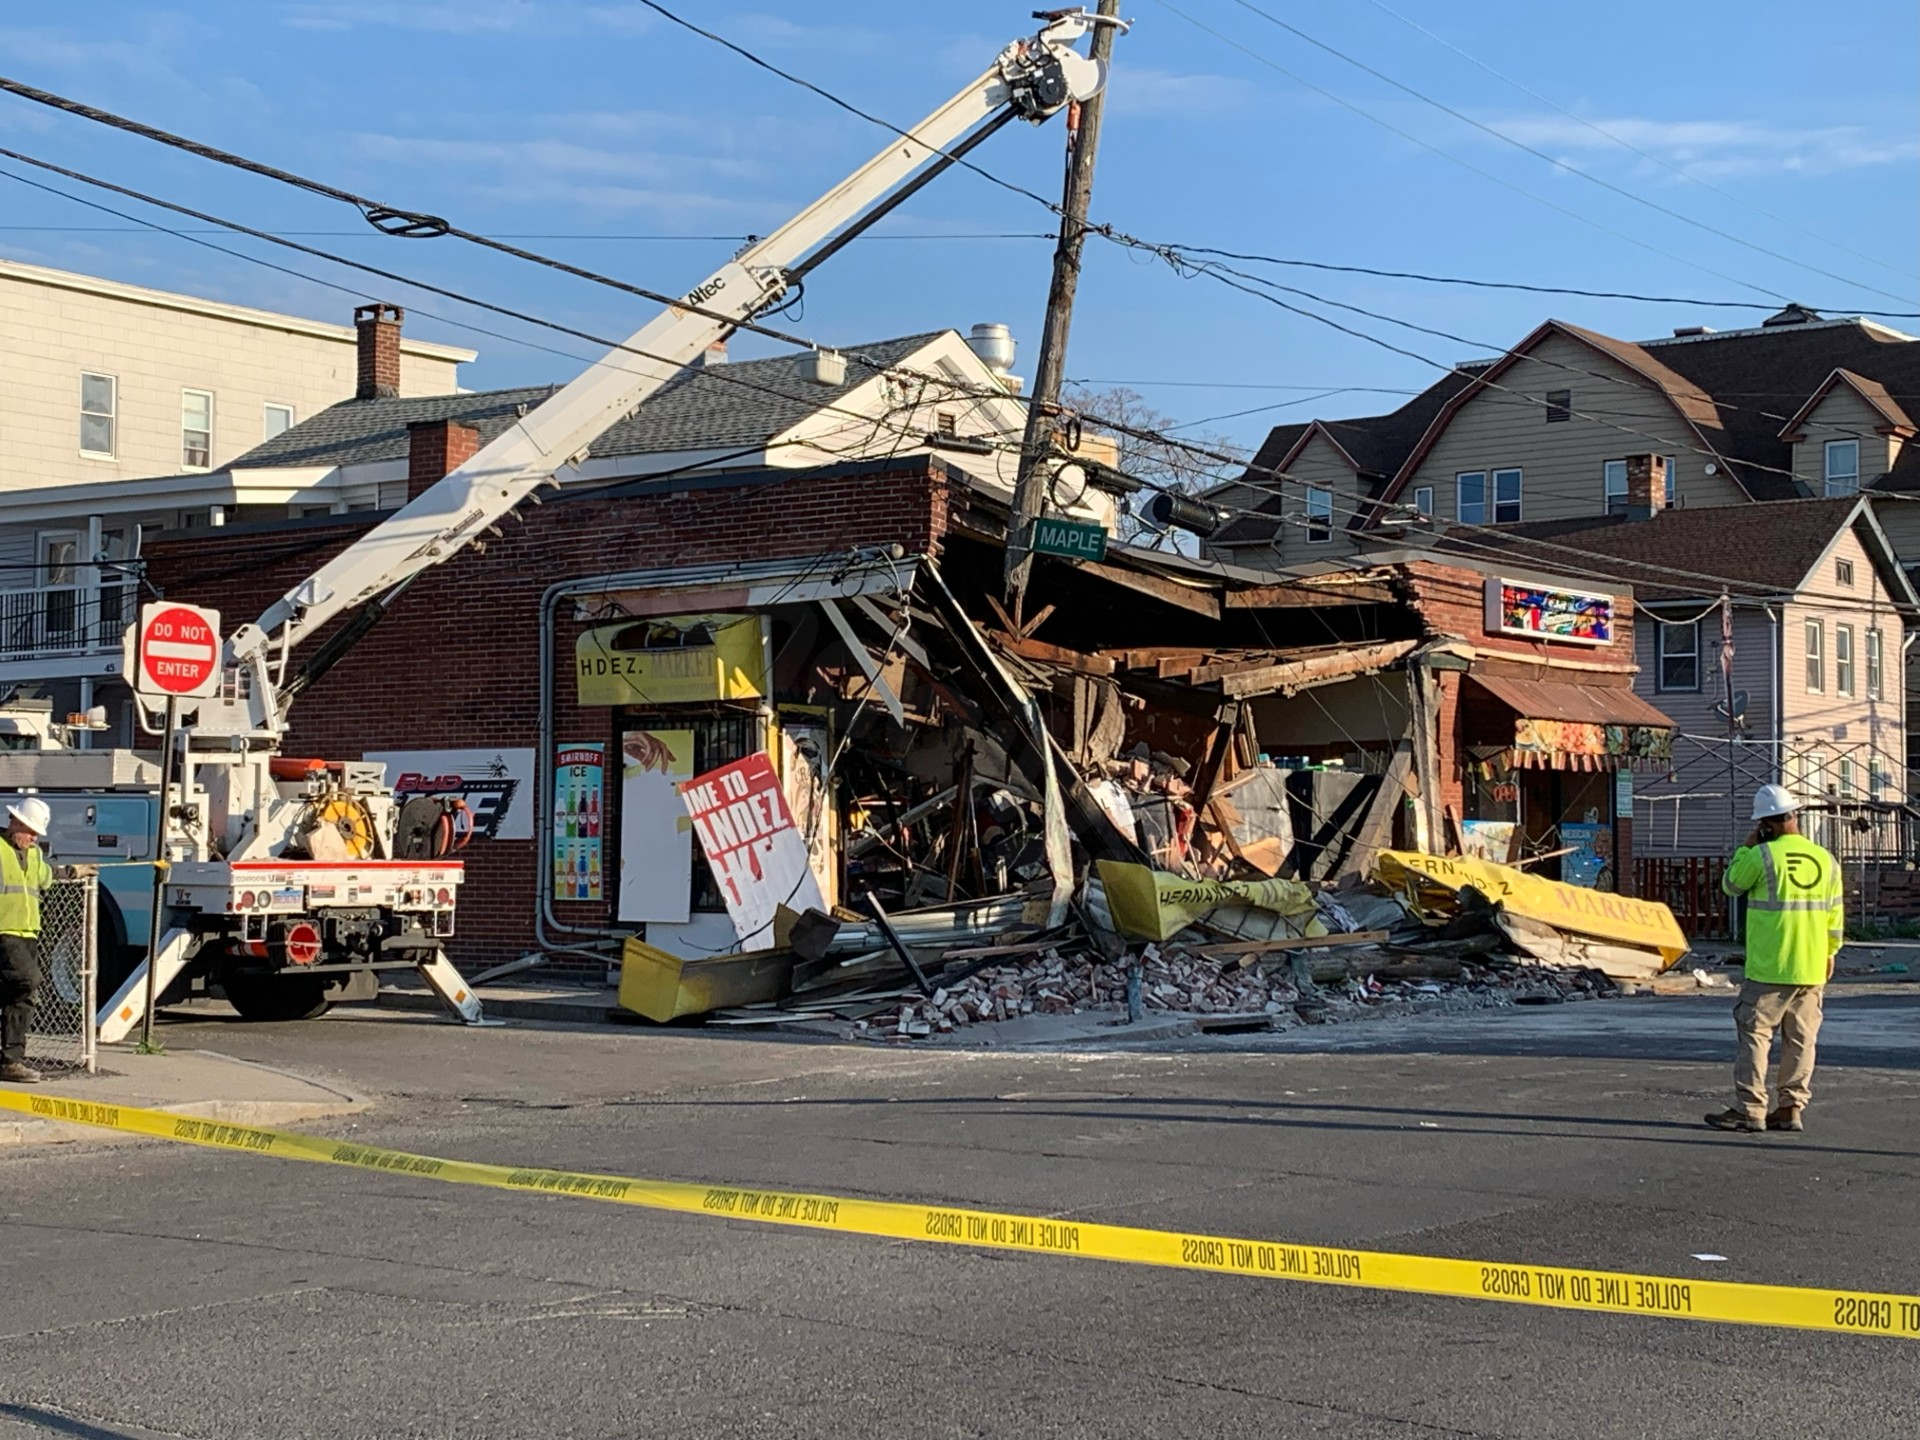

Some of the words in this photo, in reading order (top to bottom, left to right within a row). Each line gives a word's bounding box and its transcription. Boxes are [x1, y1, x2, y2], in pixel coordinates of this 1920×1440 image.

[688, 278, 725, 306] Altec
[1040, 526, 1101, 552] MAPLE
[154, 623, 173, 637] DO
[181, 625, 207, 640] NOT
[104, 663, 115, 673] 45
[157, 661, 198, 678] ENTER
[581, 657, 643, 676] HDEZ.
[560, 752, 599, 764] SMIRNOFF
[569, 767, 587, 777] ICE
[720, 770, 749, 800] TO
[1555, 887, 1671, 931] MARKET
